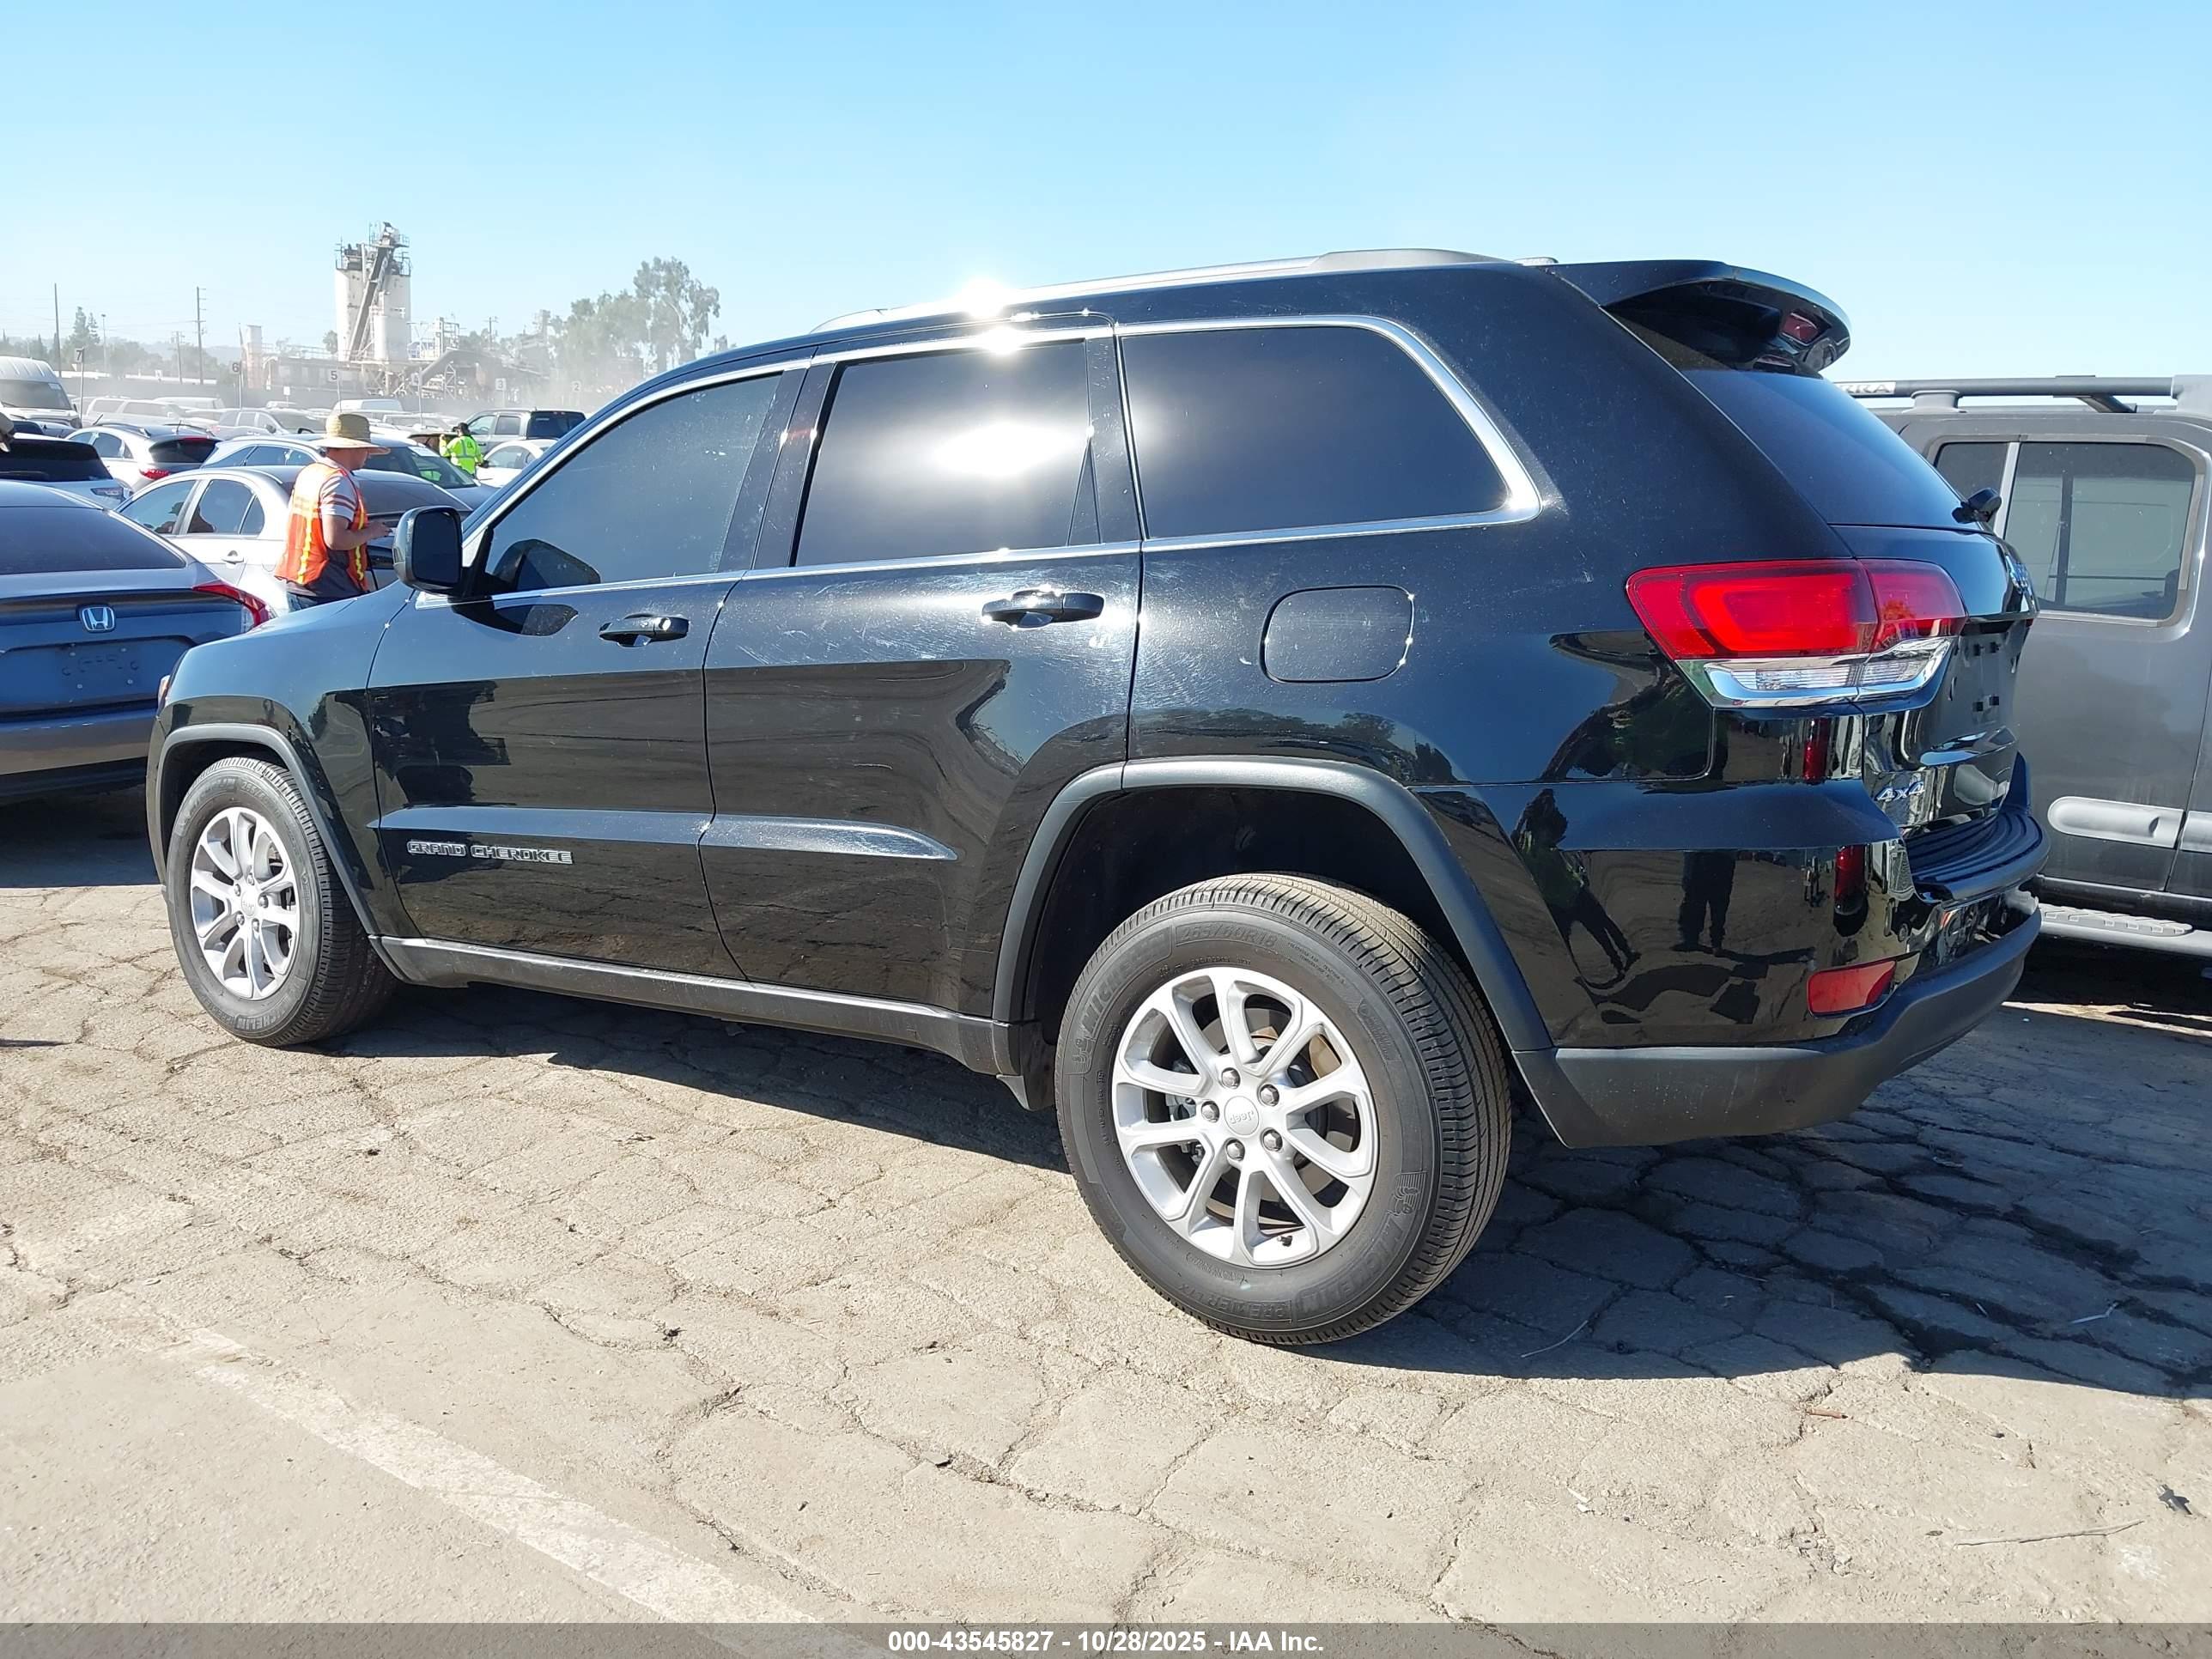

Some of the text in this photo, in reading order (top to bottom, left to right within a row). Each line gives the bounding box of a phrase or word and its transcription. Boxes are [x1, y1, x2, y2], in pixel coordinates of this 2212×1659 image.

[407, 841, 574, 865] GRAND CHEROKEE
[1230, 1110, 1255, 1124] Jeep
